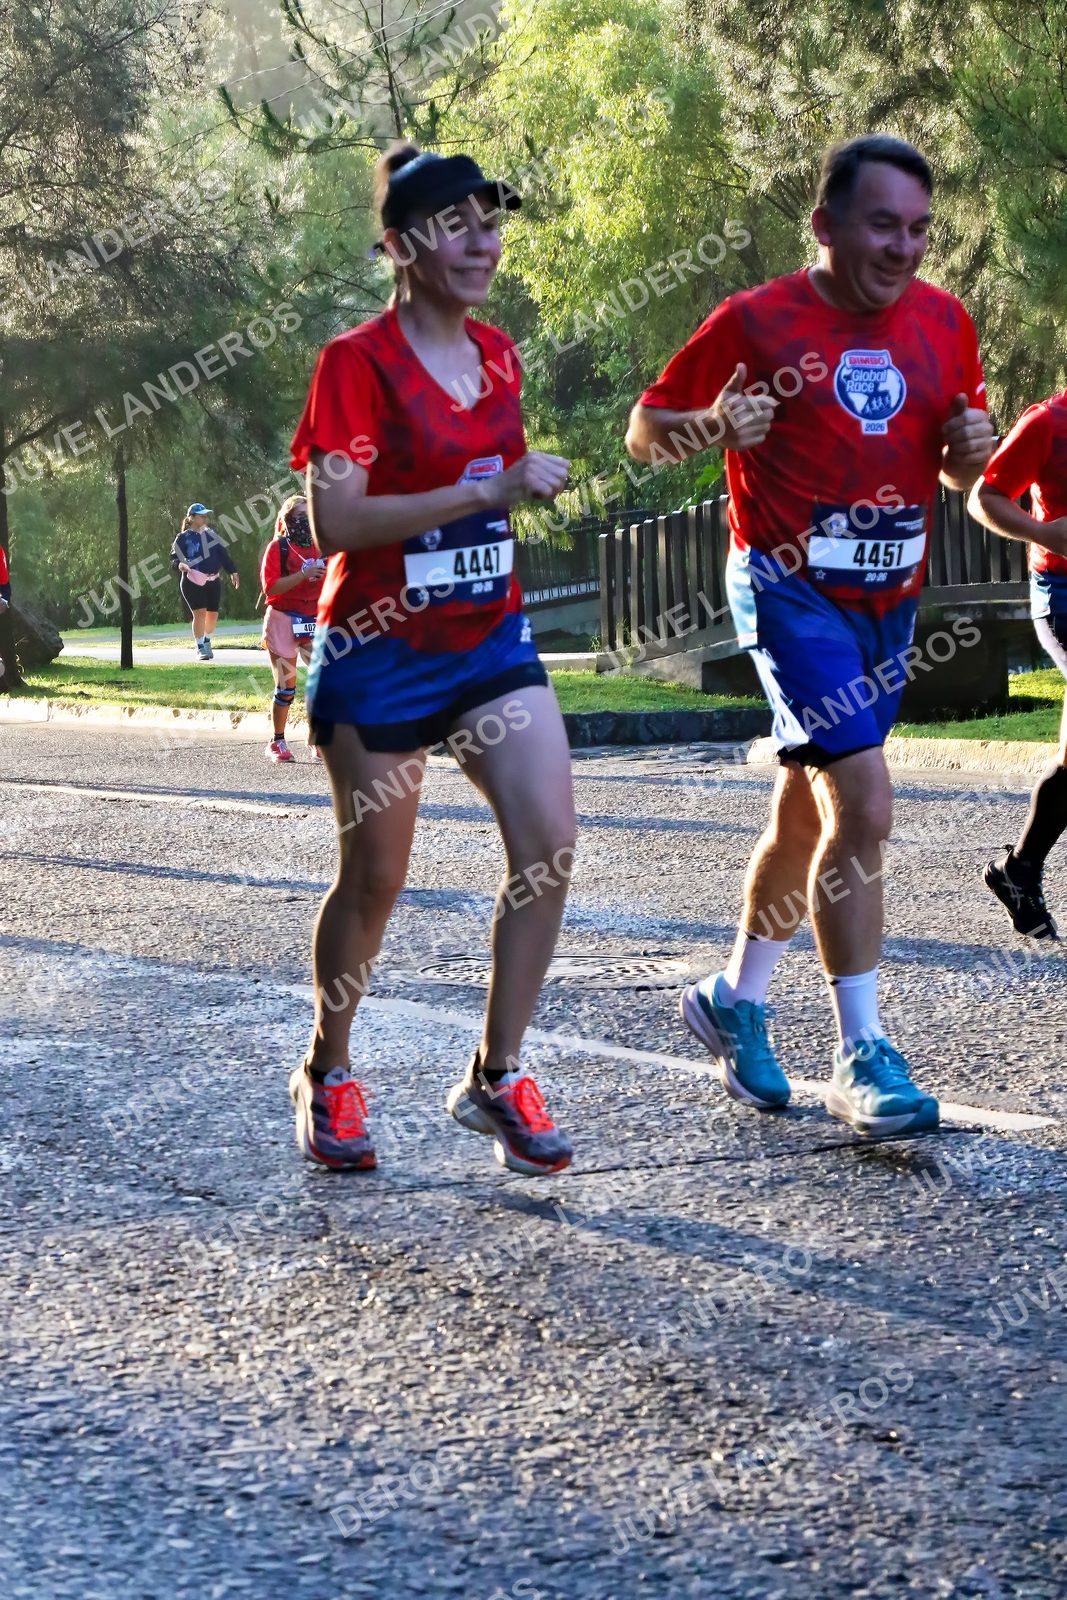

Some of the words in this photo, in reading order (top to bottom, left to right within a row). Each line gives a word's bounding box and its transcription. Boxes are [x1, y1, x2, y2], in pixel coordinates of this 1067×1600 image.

[851, 369, 888, 382] Global
[846, 380, 875, 393] Race
[864, 422, 886, 432] 2026
[853, 541, 904, 568] 4451
[453, 545, 500, 579] 4447
